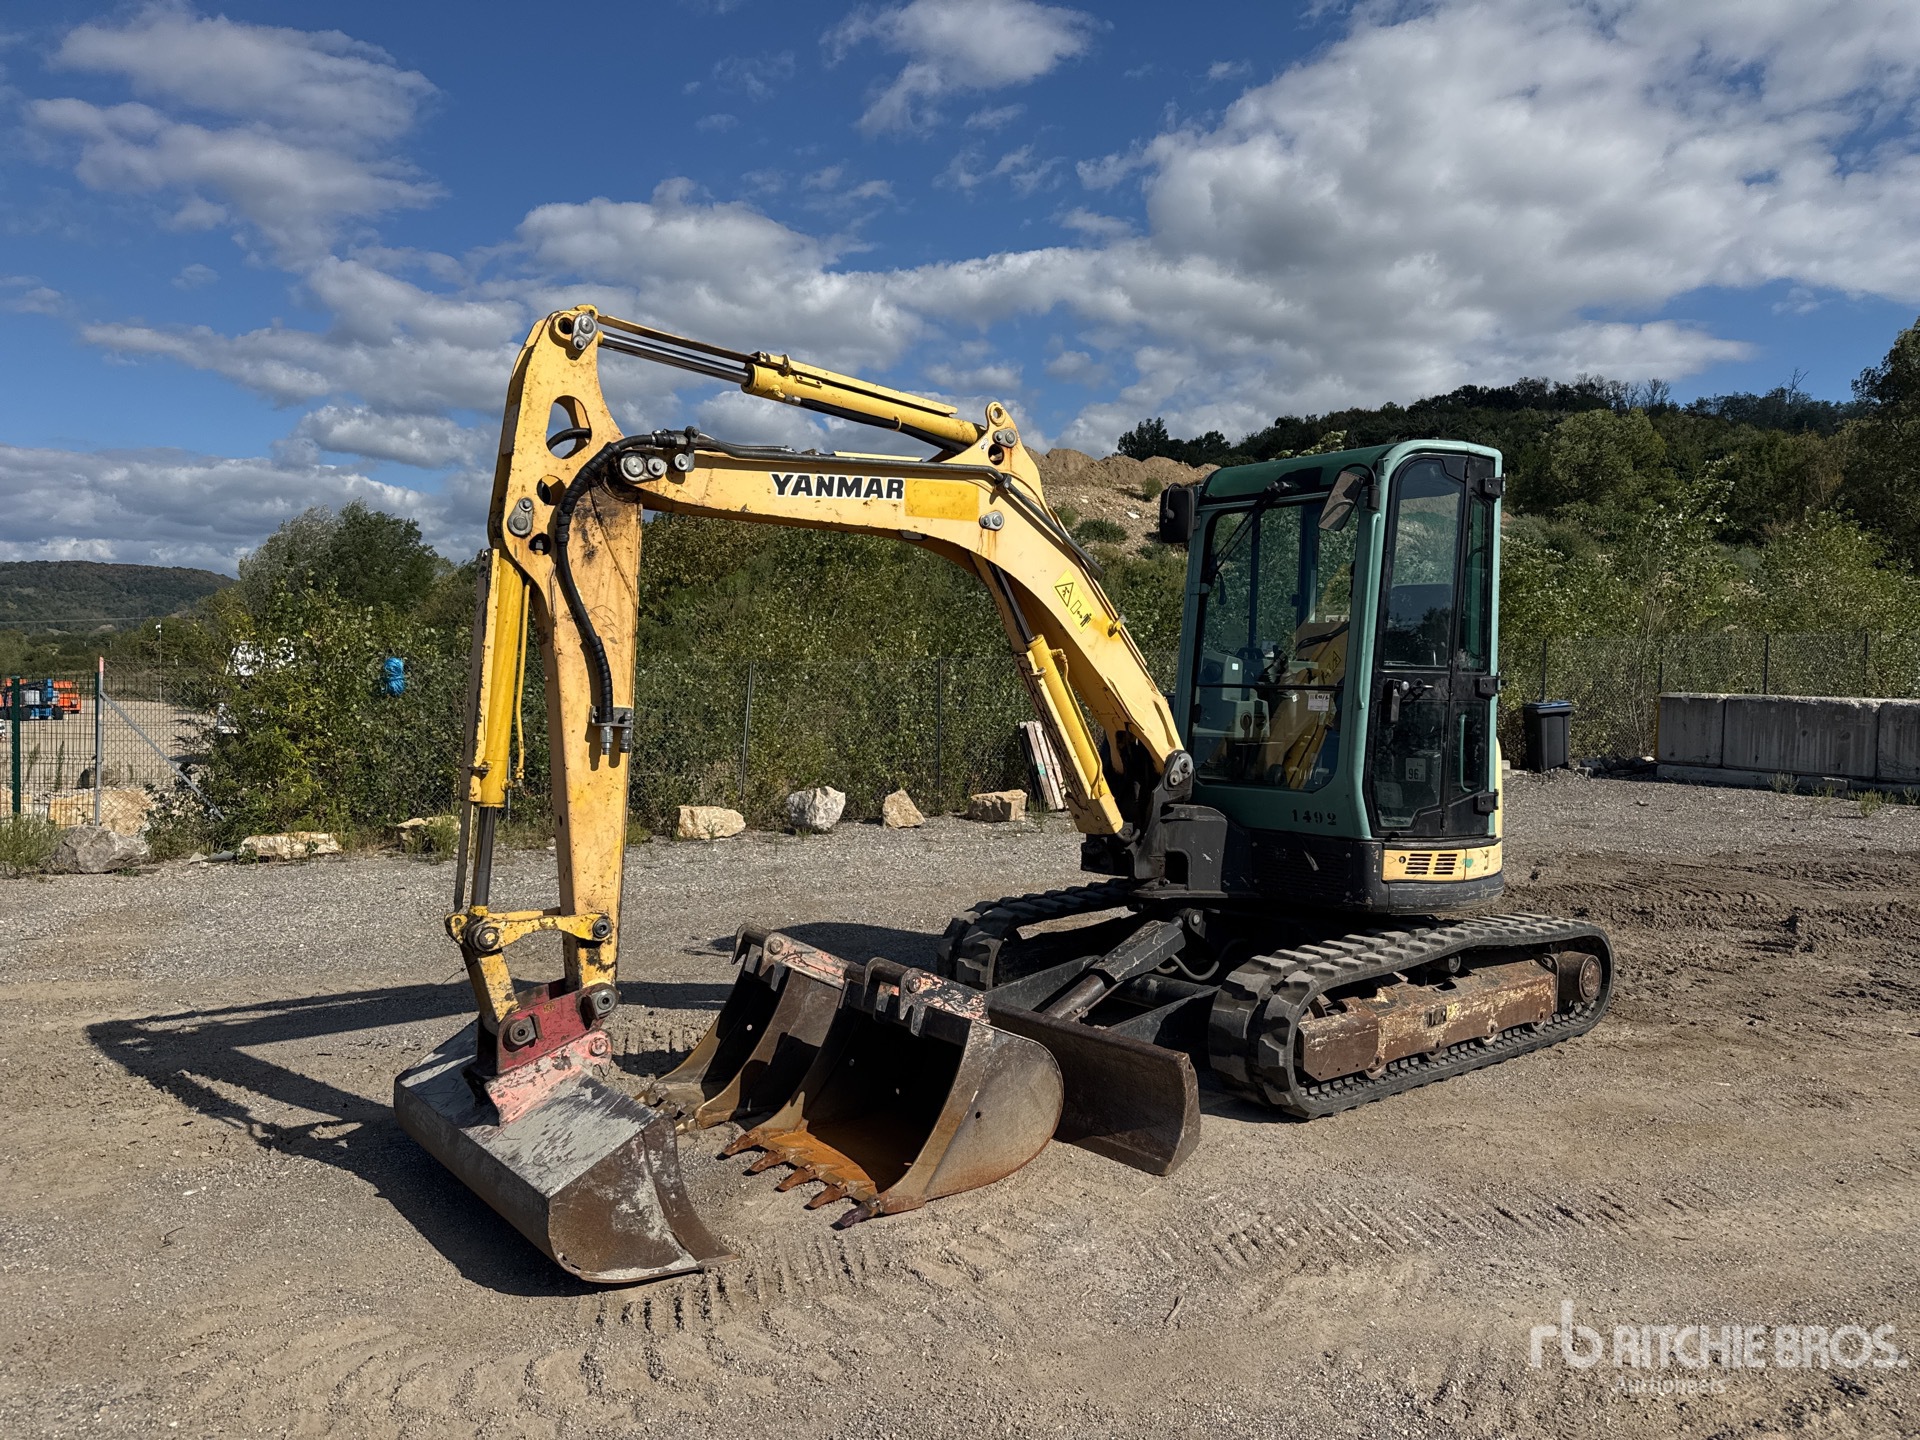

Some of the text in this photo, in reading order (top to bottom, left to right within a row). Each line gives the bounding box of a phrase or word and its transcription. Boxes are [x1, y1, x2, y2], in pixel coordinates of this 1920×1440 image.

[771, 473, 904, 499] YANMAR
[1408, 768, 1419, 780] 96
[1291, 809, 1337, 826] 1492
